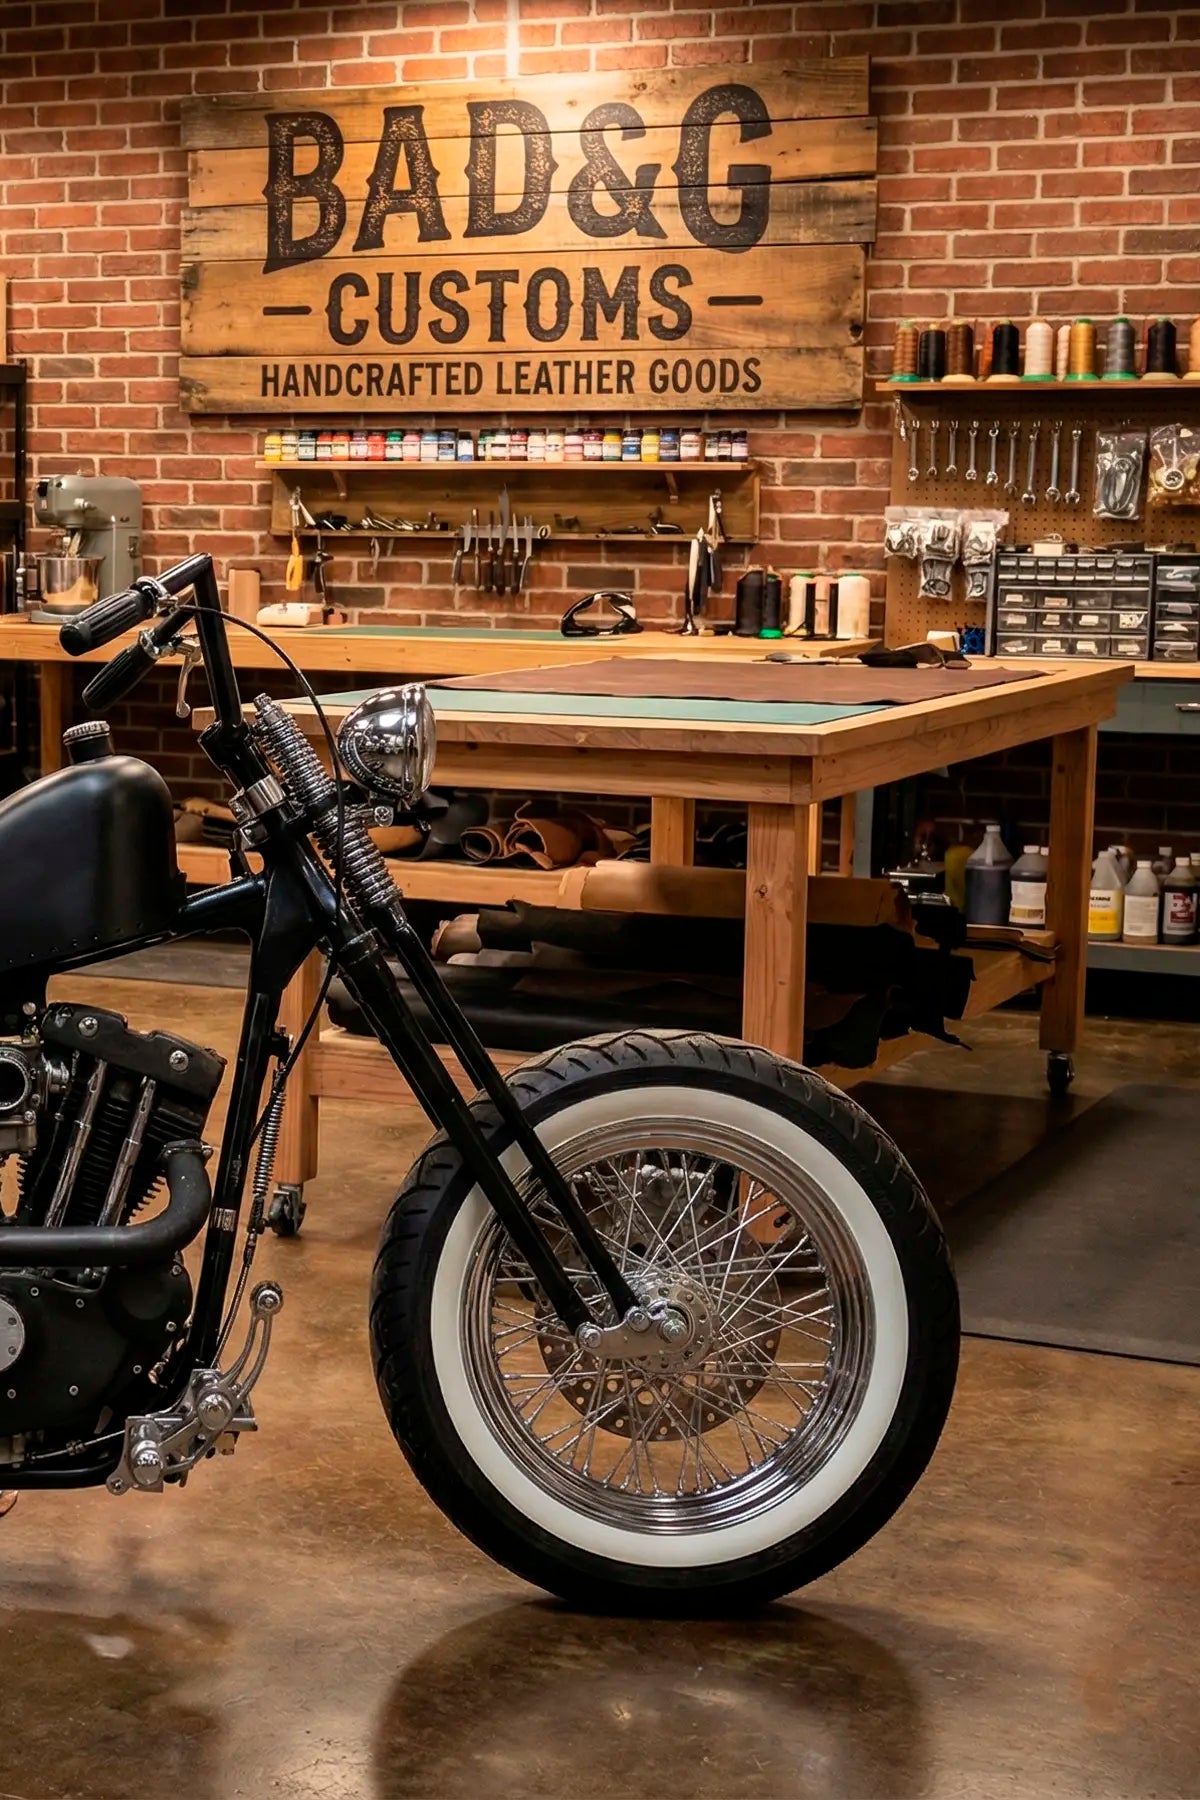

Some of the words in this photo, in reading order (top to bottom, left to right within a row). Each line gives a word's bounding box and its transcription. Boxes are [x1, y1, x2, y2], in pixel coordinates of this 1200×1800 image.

[262, 83, 772, 274] BAD&G
[325, 263, 693, 346] CUSTOMS
[261, 361, 484, 397] HANDCRAFTED
[496, 359, 635, 395] LEATHER
[650, 357, 762, 394] GOODS
